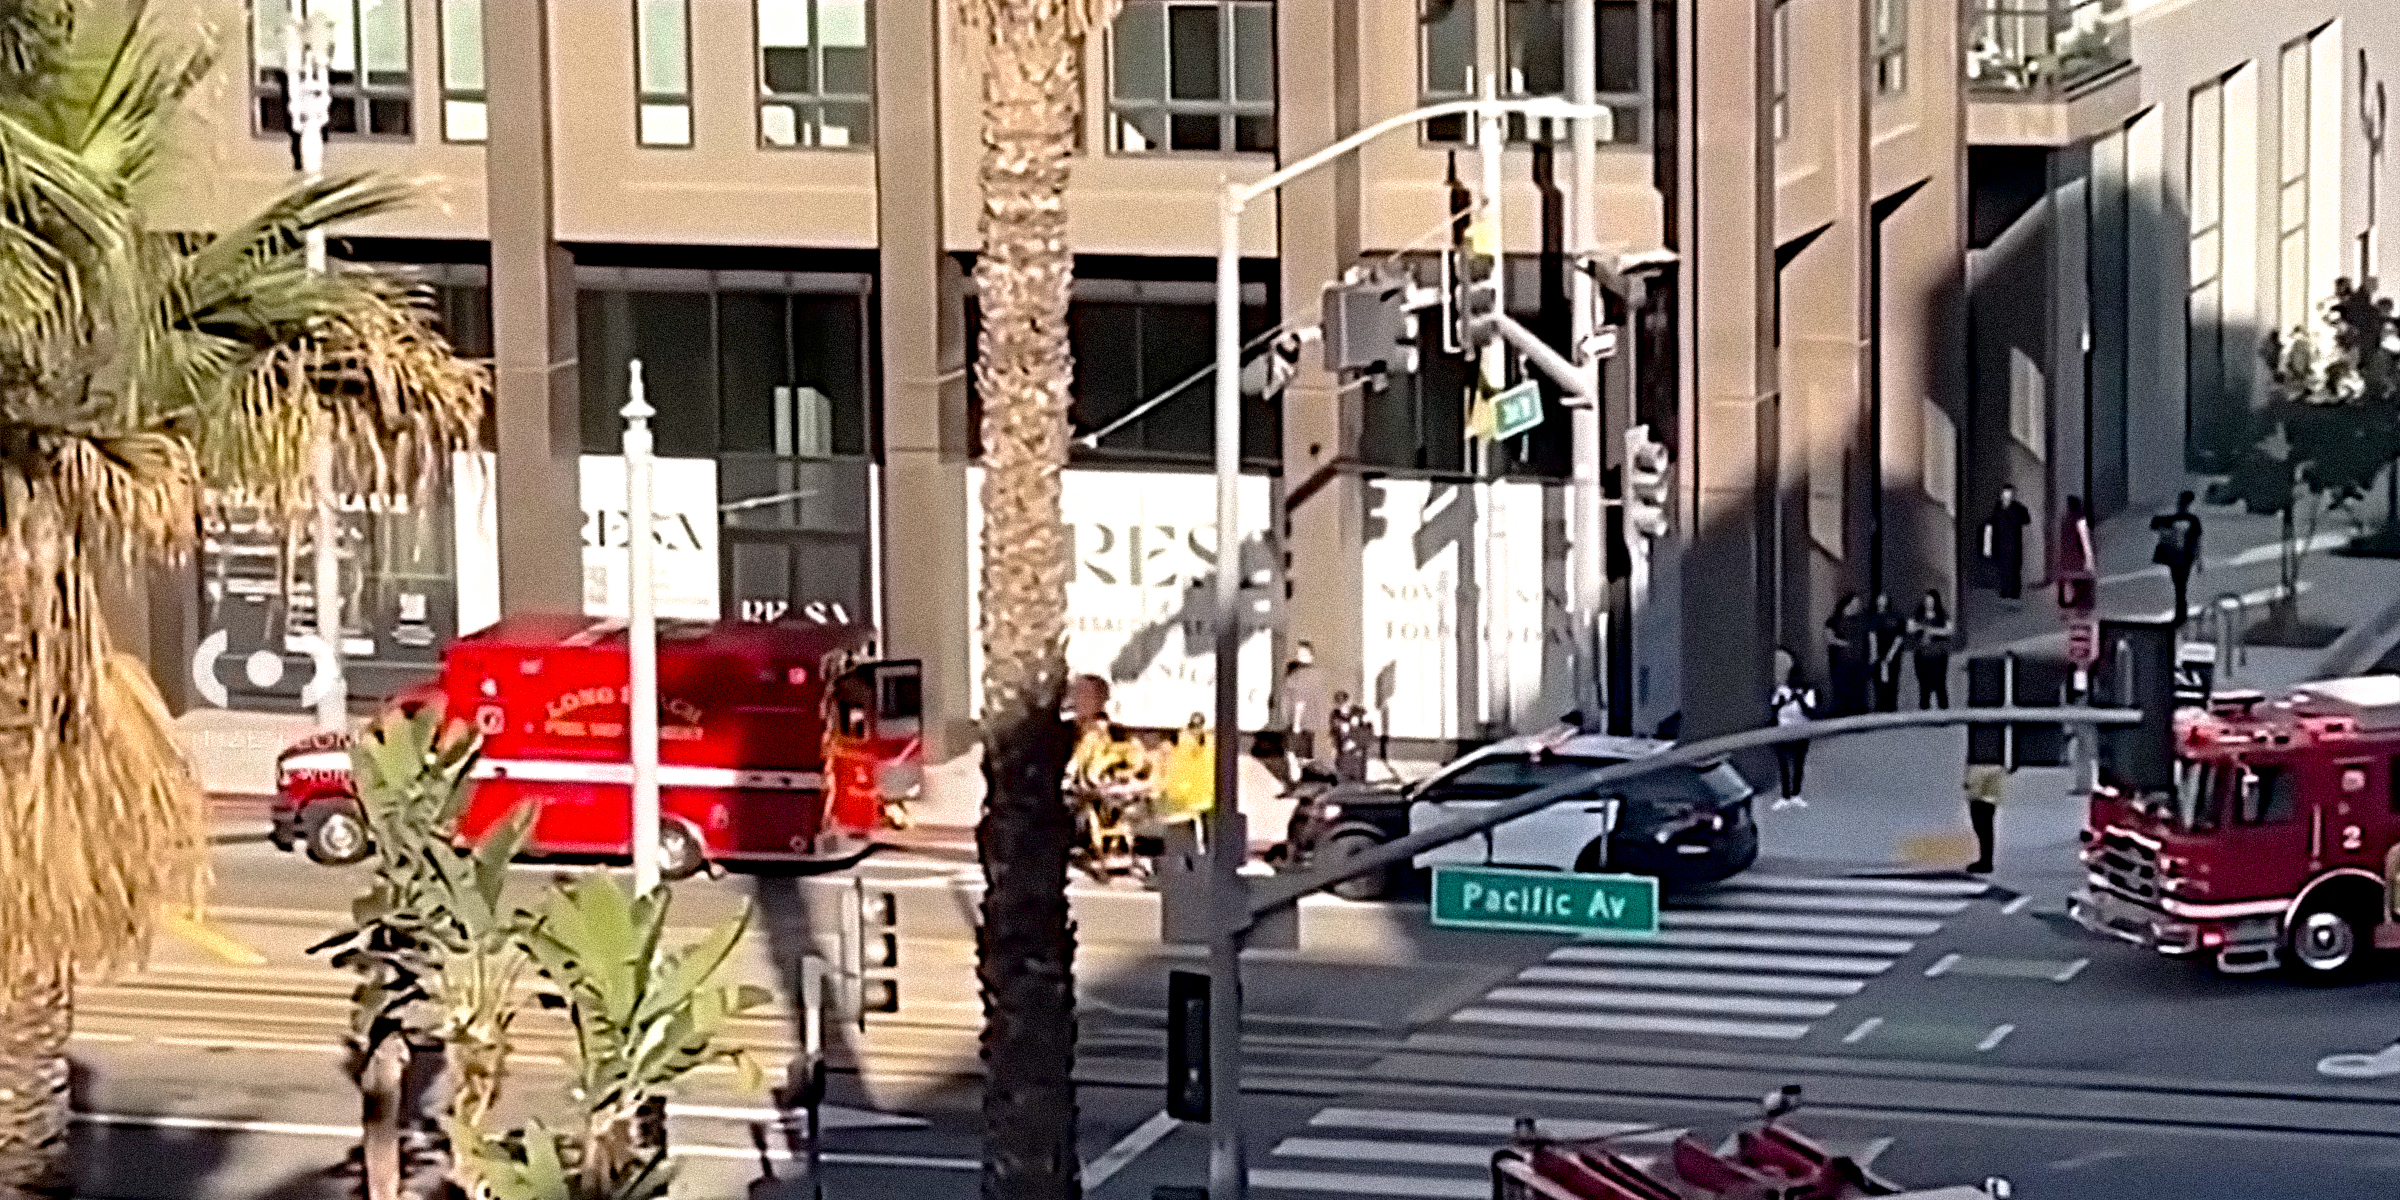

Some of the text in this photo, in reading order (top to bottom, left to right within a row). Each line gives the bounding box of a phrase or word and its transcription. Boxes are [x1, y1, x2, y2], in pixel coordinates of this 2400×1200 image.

[581, 509, 703, 550] ESA
[1060, 522, 1272, 588] RES
[545, 684, 703, 724] LONG BCH
[2342, 824, 2361, 850] 2
[1463, 881, 1627, 919] Pacific Av
